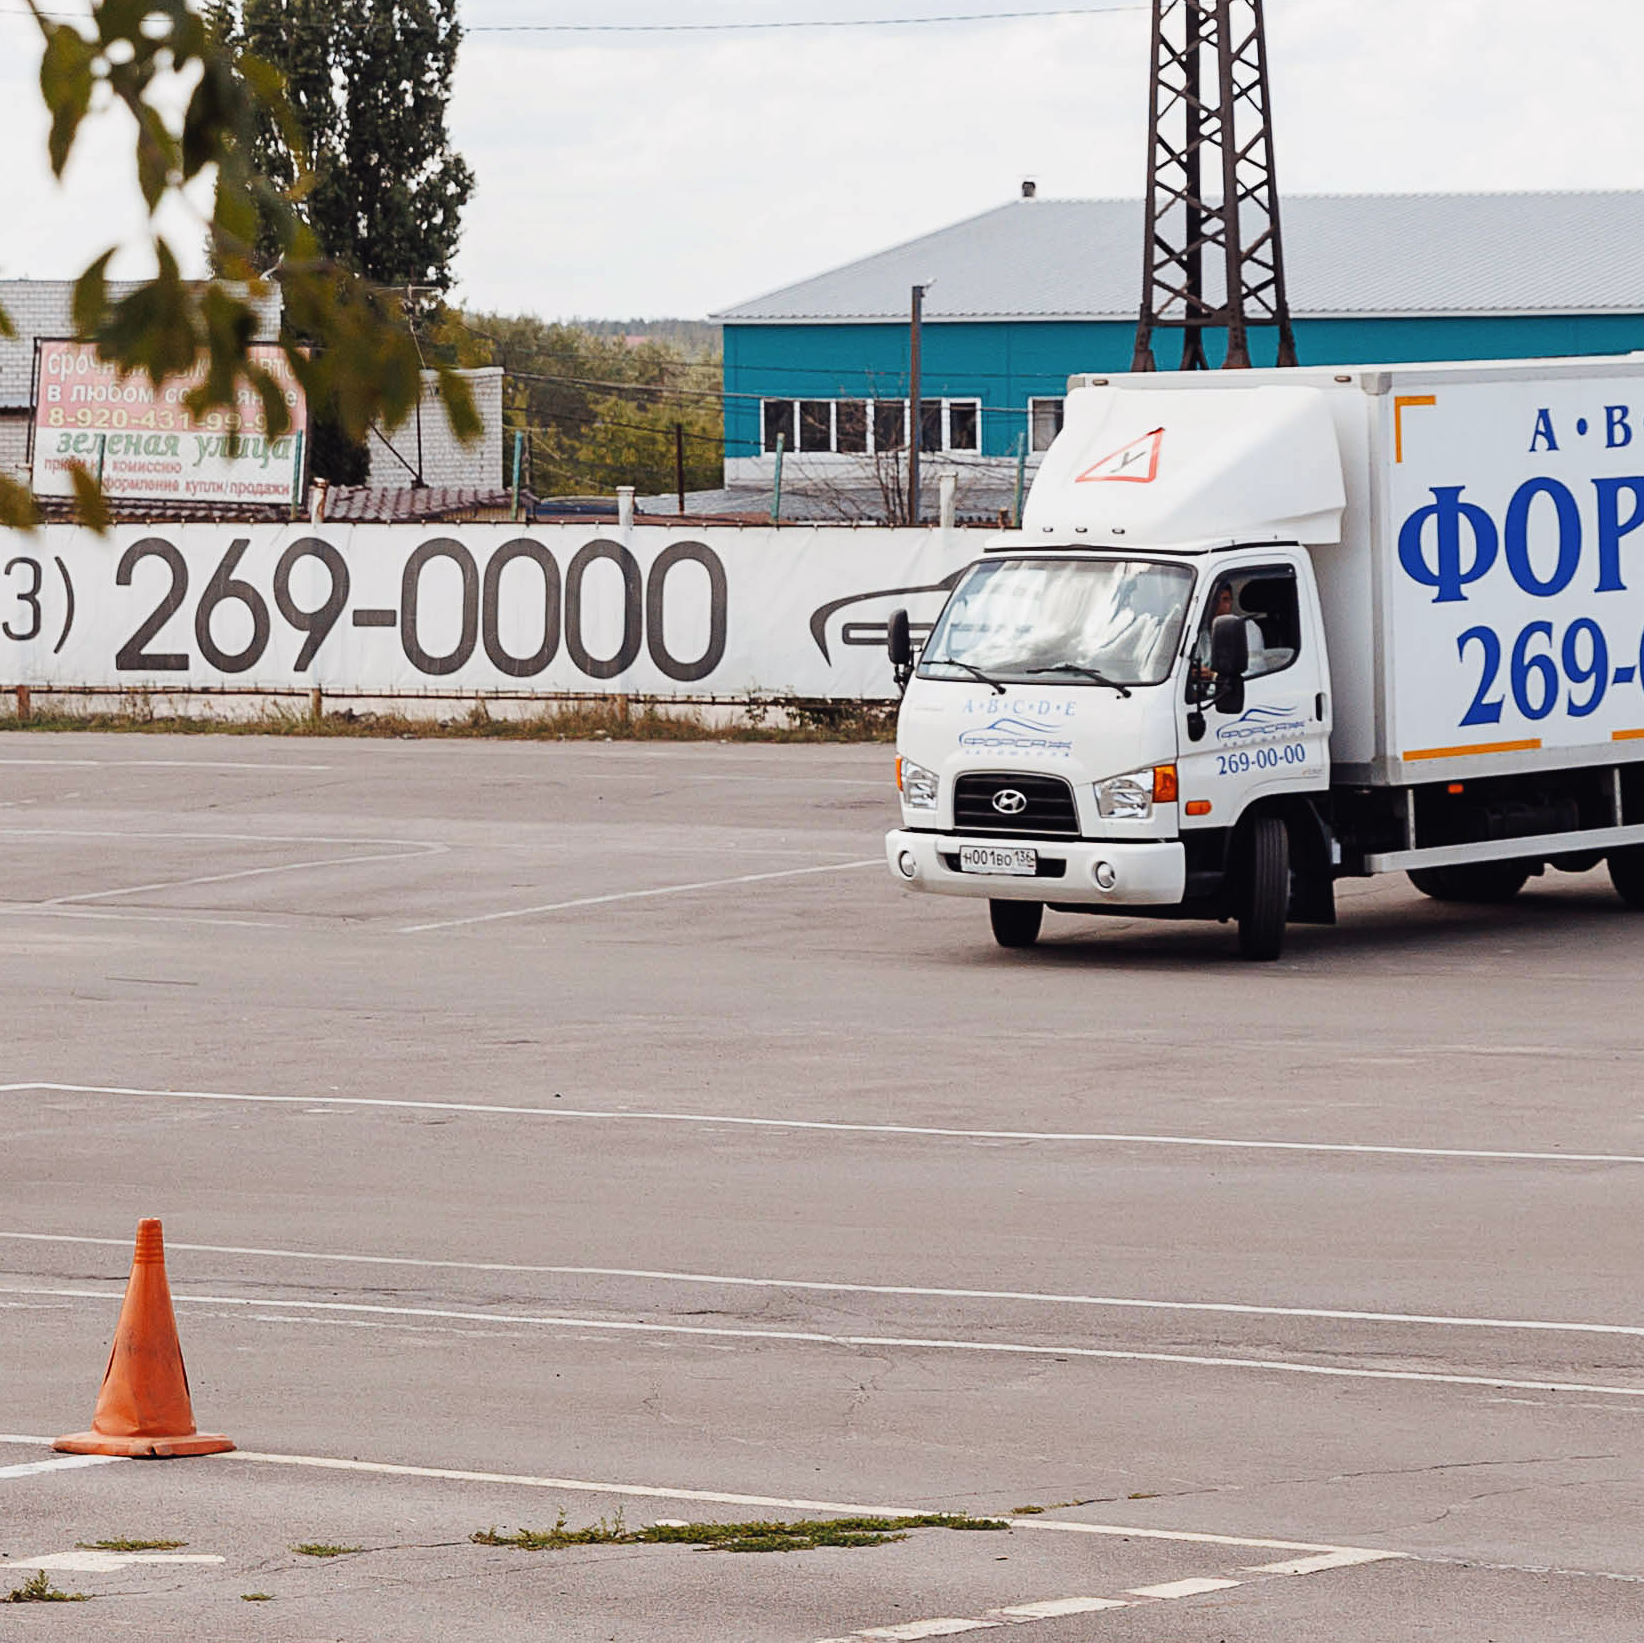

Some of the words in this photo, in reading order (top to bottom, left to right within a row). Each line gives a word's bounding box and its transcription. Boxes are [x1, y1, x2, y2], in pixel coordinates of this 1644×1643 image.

[47, 384, 61, 402] в
[69, 380, 154, 404] любом
[48, 407, 291, 434] 8-920-431-99-9
[57, 432, 180, 457] зеленая
[192, 434, 293, 469] улица
[115, 536, 727, 682] 269-0000
[1216, 743, 1305, 775] 269-00-00
